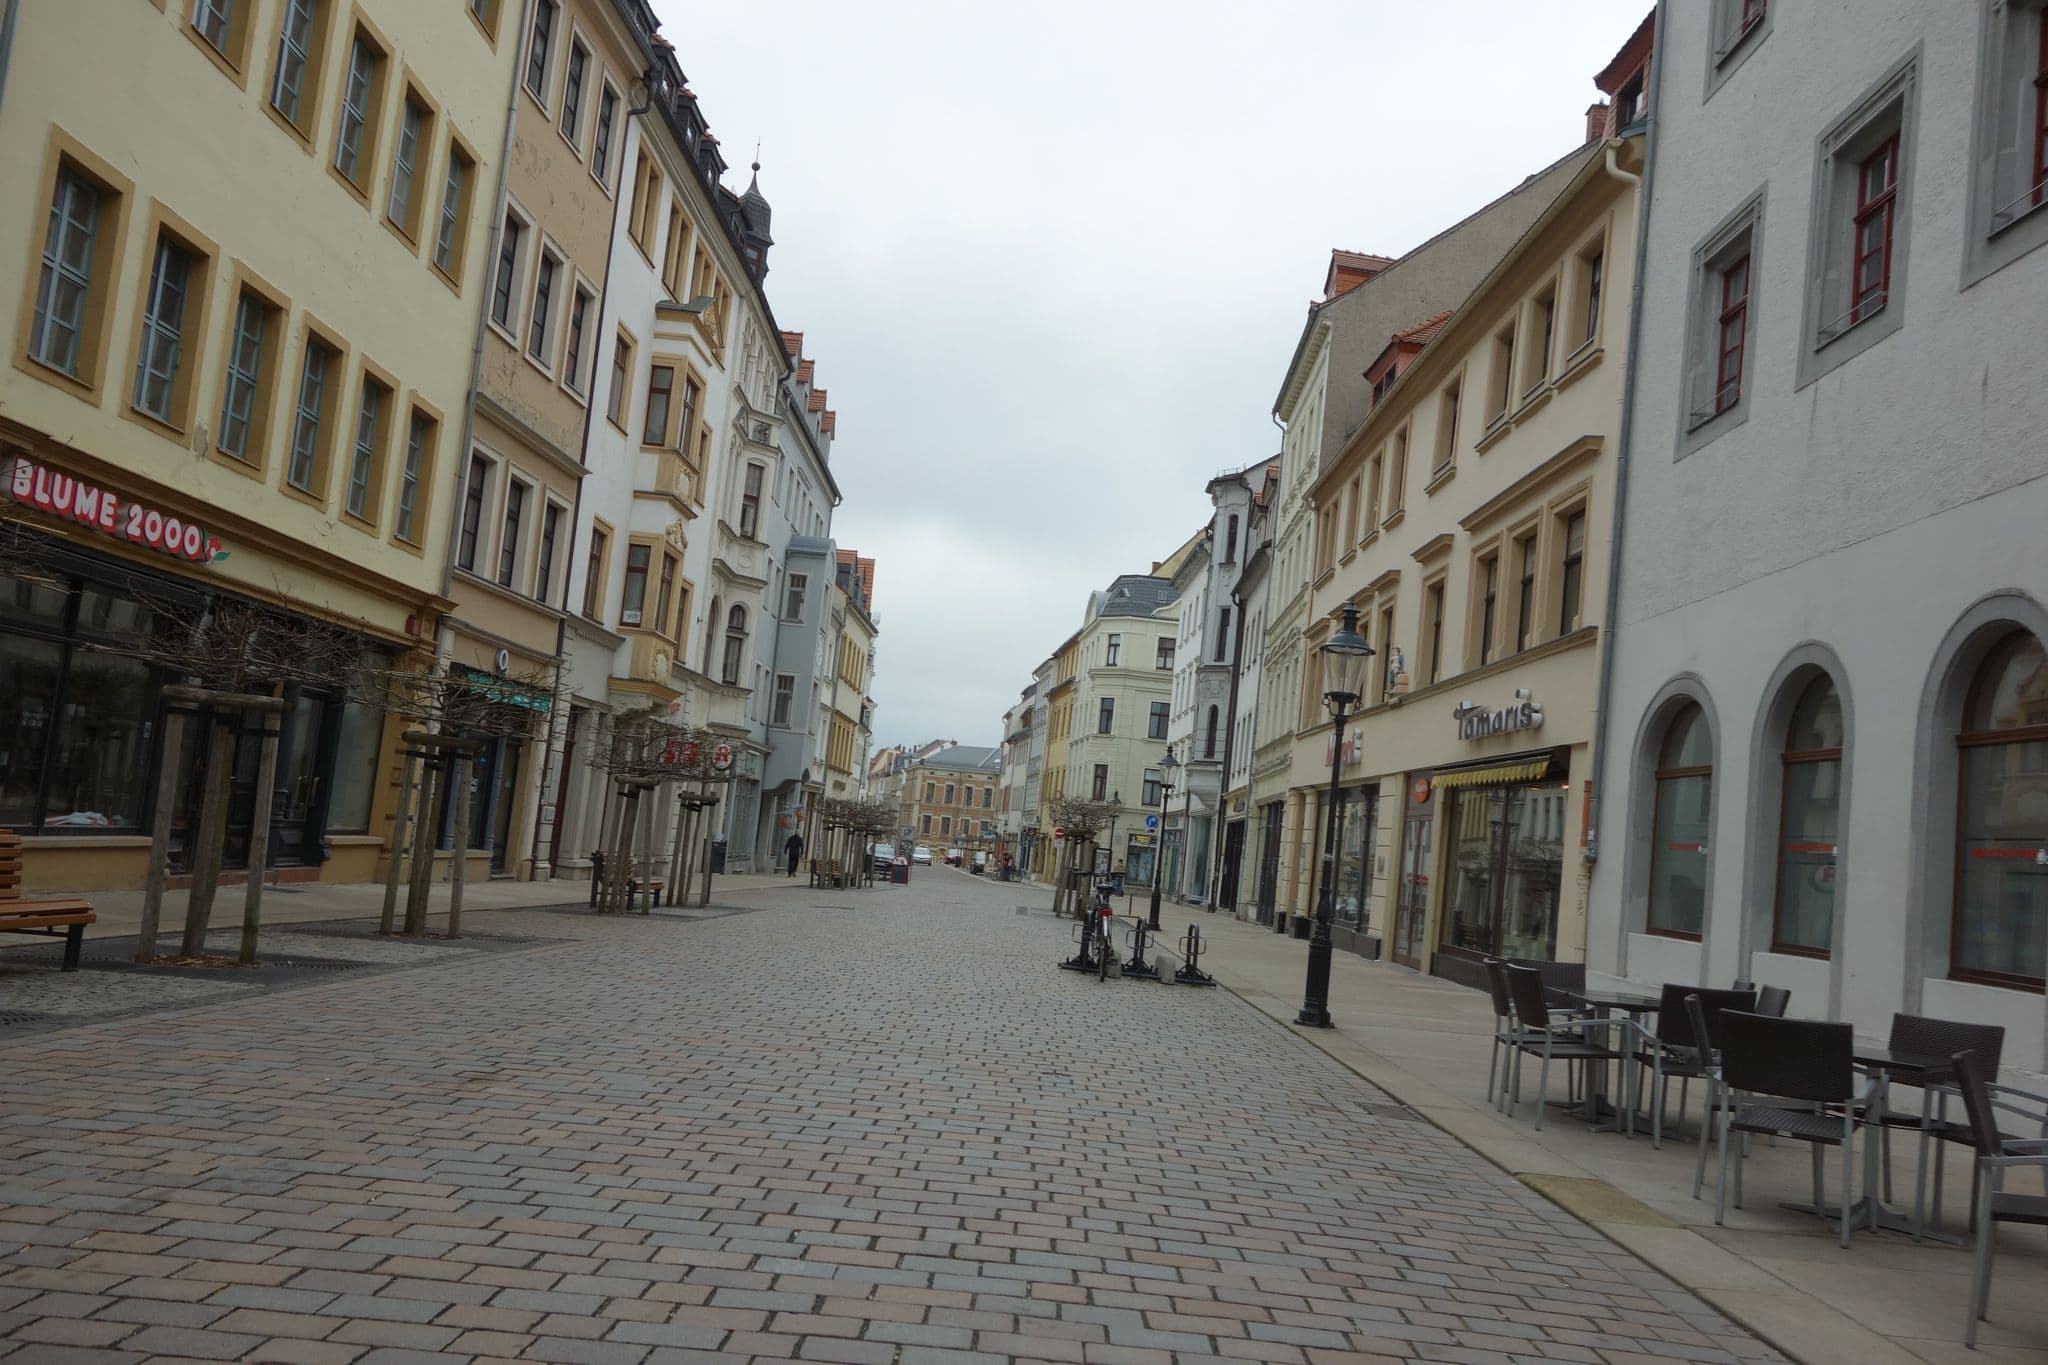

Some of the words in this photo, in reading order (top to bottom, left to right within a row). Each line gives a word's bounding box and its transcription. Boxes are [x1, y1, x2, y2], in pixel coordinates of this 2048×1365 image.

[12, 458, 118, 529] BLUME
[126, 504, 202, 557] 2000
[1453, 688, 1543, 740] Tamaris
